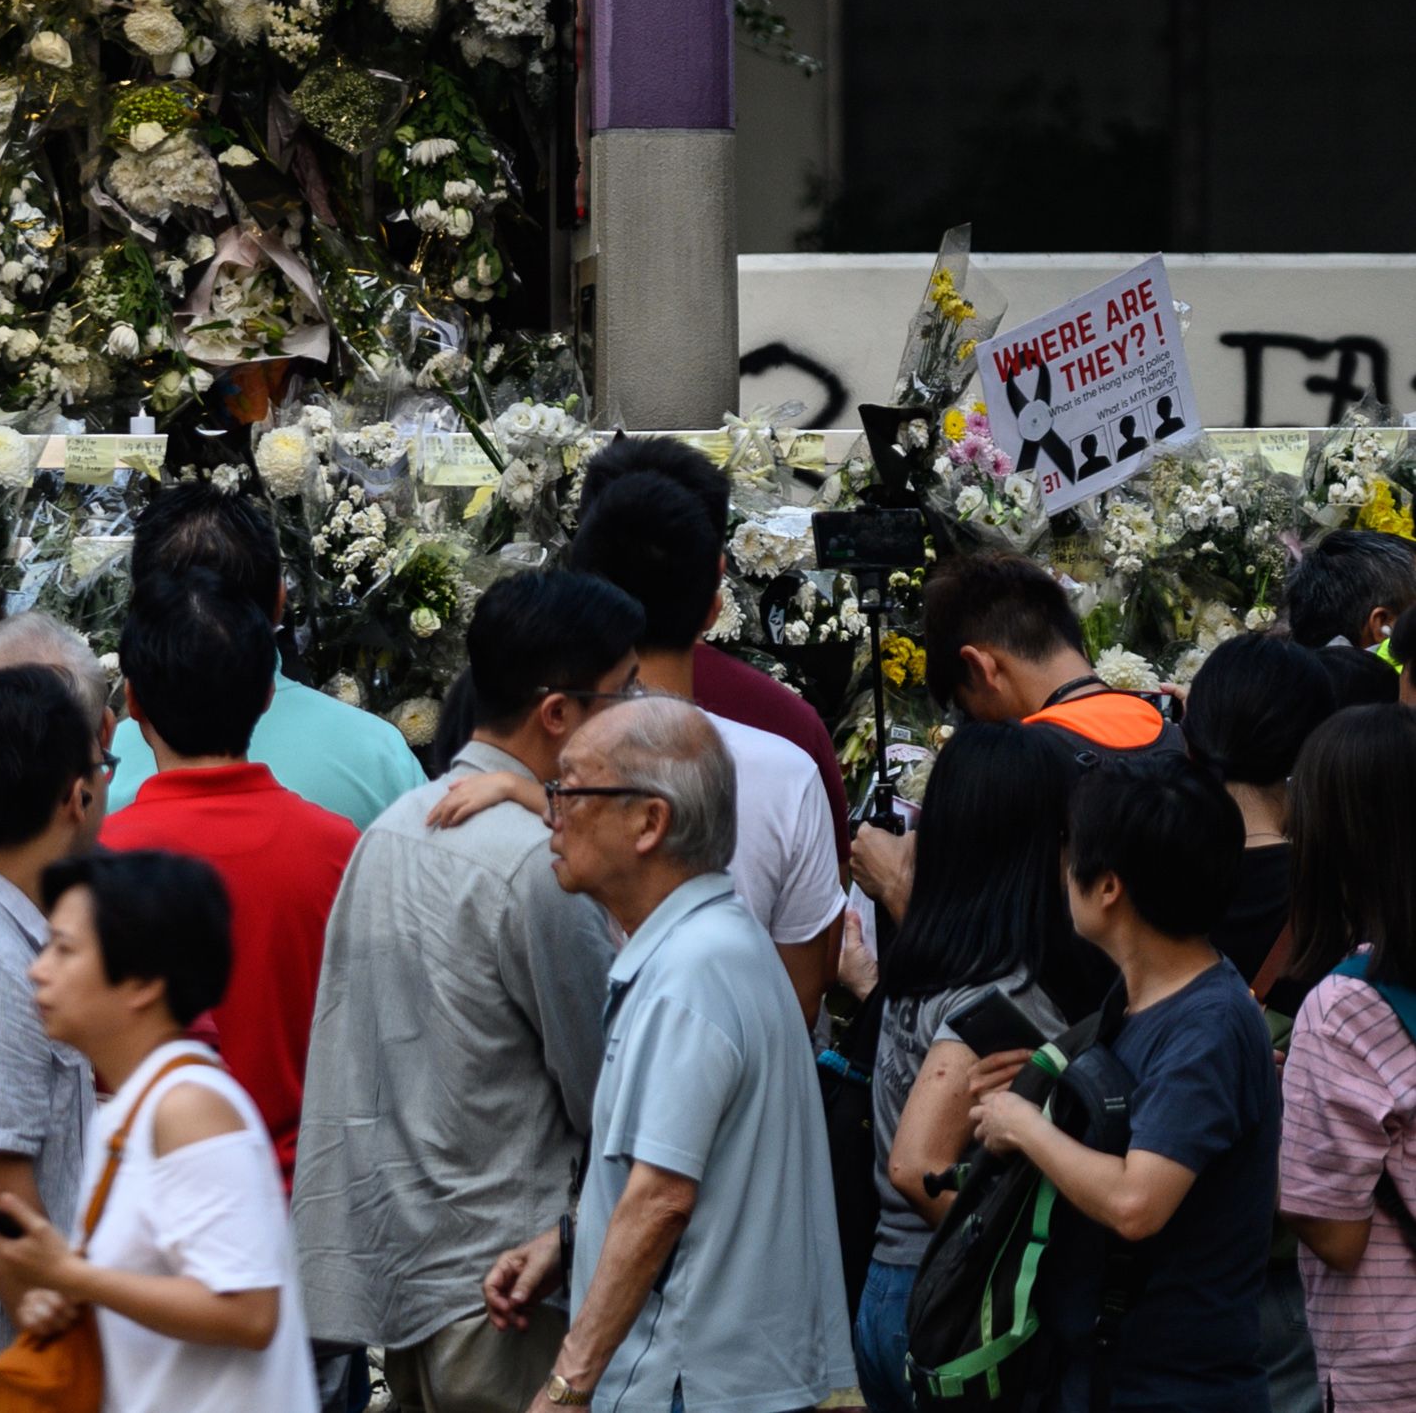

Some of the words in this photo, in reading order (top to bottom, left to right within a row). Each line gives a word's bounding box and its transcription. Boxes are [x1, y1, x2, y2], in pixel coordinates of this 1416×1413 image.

[993, 311, 1097, 384] WHERE
[1106, 278, 1158, 332] ARE
[1048, 400, 1073, 419] What
[1073, 394, 1082, 406] is
[1082, 388, 1098, 403] the
[1098, 376, 1122, 395] Hong
[1122, 364, 1145, 382] Kong
[1145, 350, 1171, 372] police
[1096, 402, 1121, 421] What
[1120, 398, 1129, 409] is
[1129, 388, 1148, 405] MTR
[1149, 371, 1178, 396] hiding?
[1141, 359, 1175, 386] hiding??
